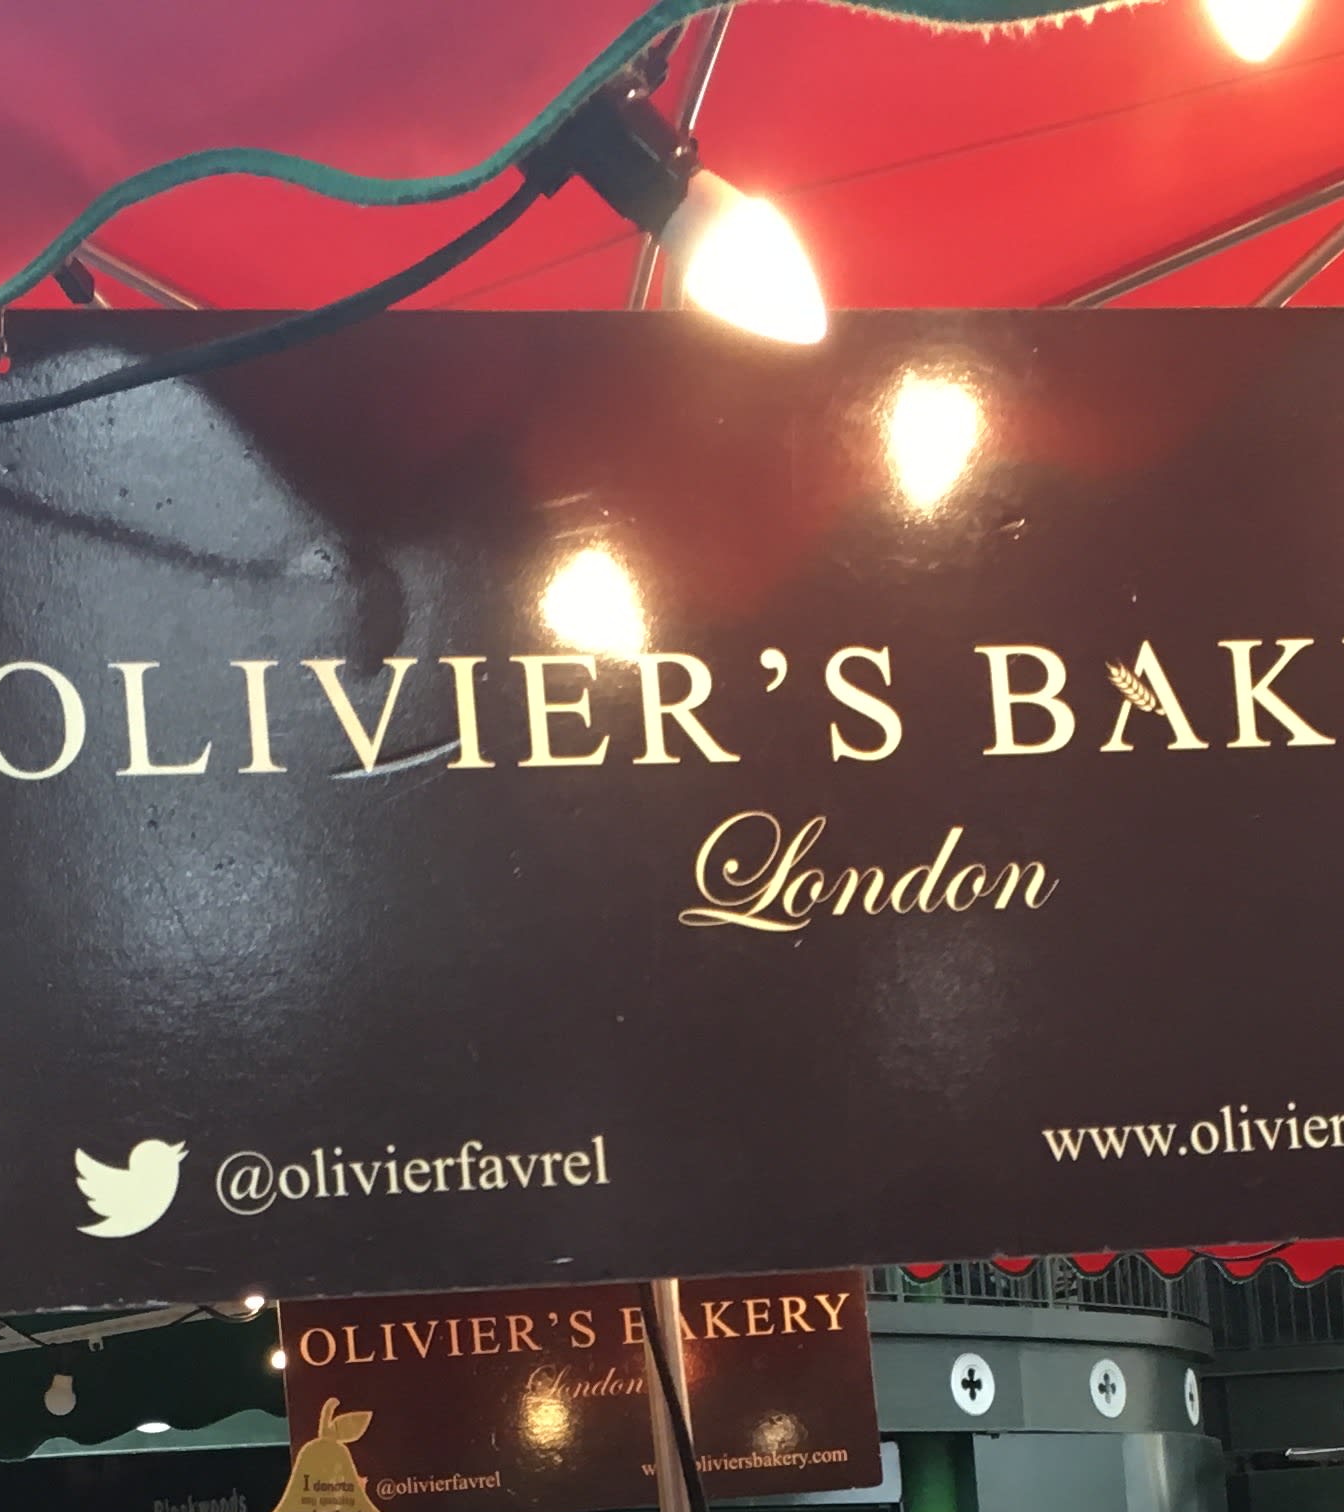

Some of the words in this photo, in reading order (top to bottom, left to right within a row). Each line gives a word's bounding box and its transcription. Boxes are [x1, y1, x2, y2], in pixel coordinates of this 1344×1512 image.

[677, 809, 1060, 933] London
[215, 1136, 612, 1216] @olivierfavrel
[298, 1307, 598, 1368] OLIVIER'S
[523, 1364, 644, 1406] London
[375, 1470, 502, 1501] @olivierfavrel
[641, 1445, 849, 1479] woliviersbakery.com
